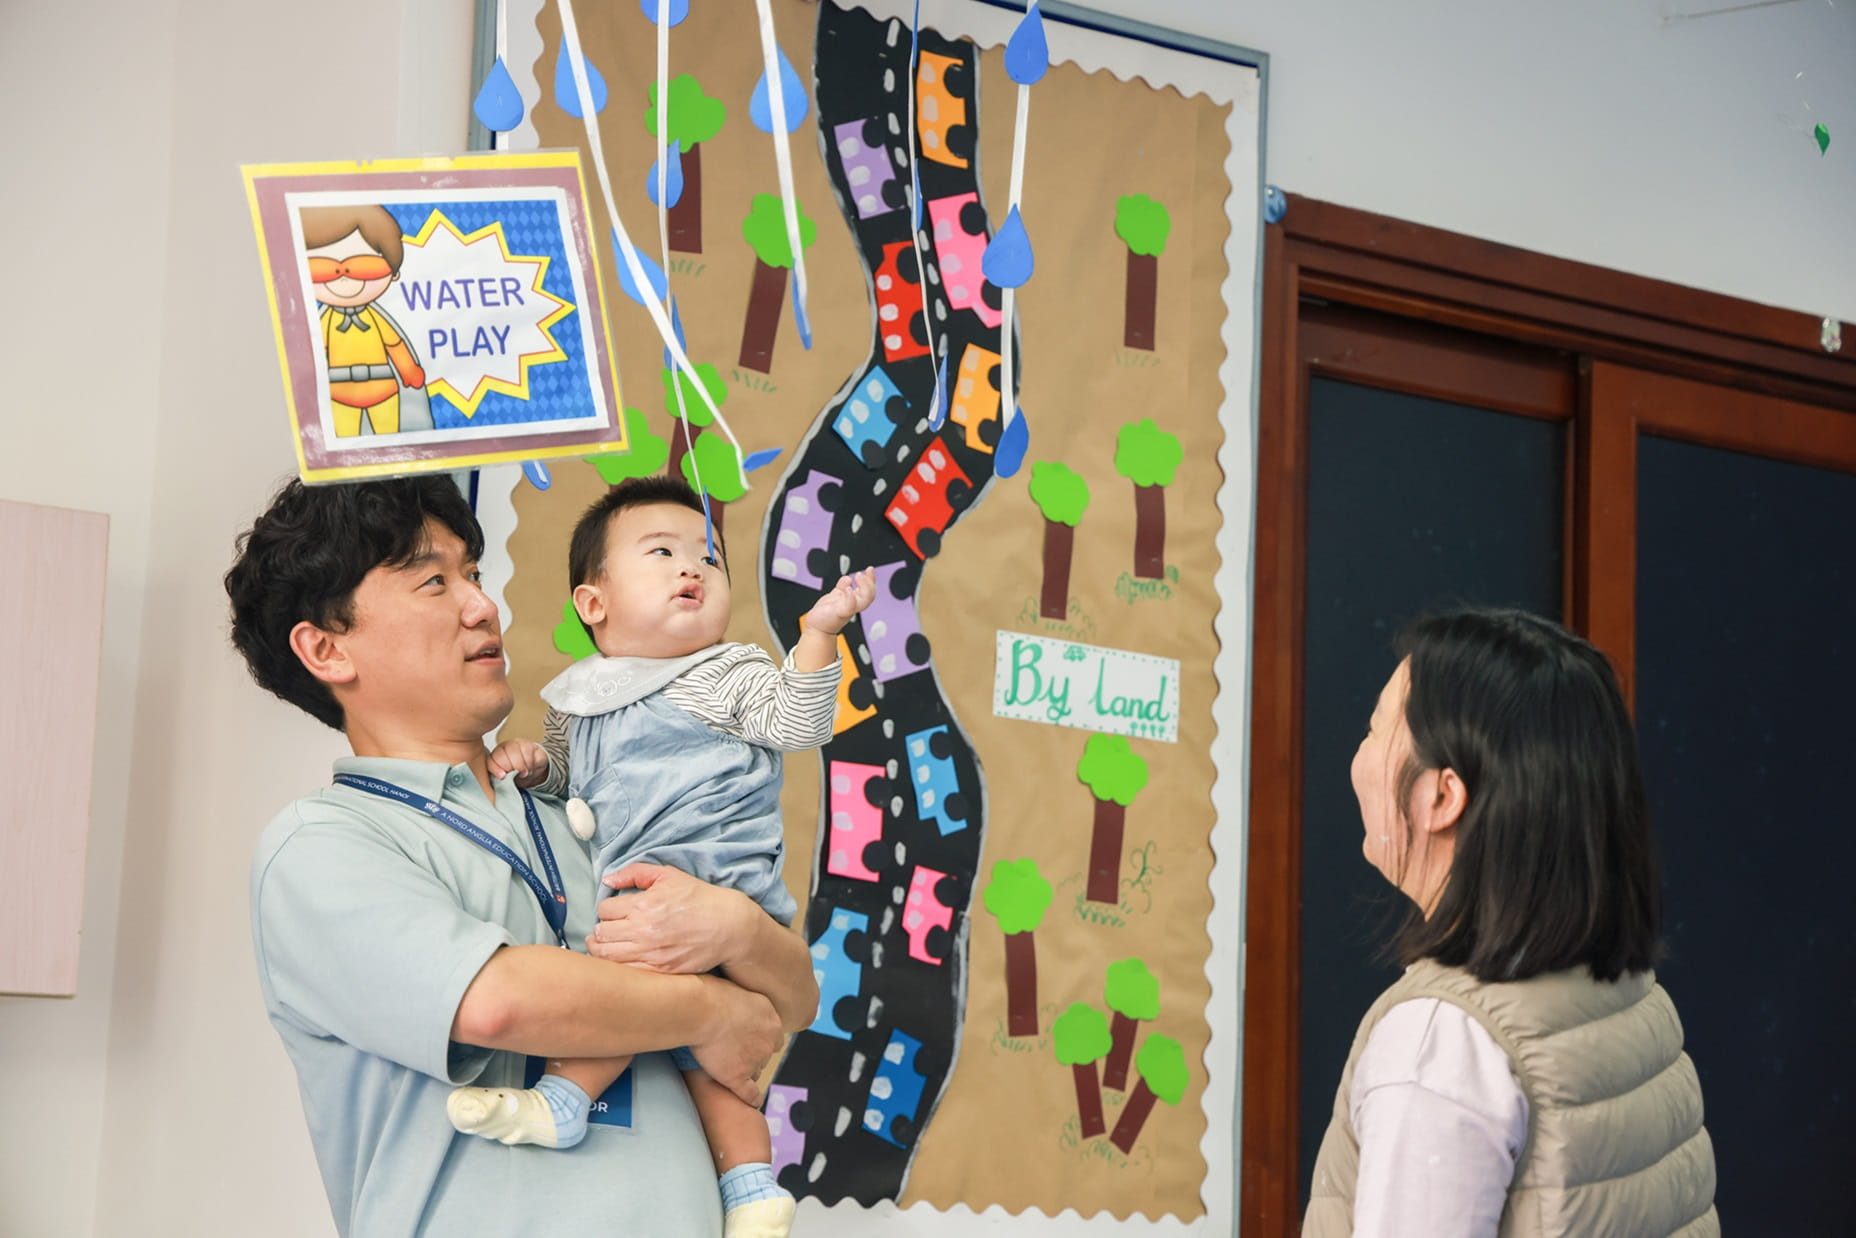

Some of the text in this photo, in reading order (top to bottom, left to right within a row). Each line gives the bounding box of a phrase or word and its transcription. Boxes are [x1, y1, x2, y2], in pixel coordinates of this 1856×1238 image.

[400, 277, 525, 311] WATER
[428, 325, 511, 359] PLAY
[1004, 640, 1170, 722] By land
[367, 781, 390, 793] SCHOOL
[446, 815, 468, 830] NORD
[466, 827, 492, 846] ANGLIA
[491, 842, 530, 876] EDUCATION
[527, 873, 548, 904] SCHOOL
